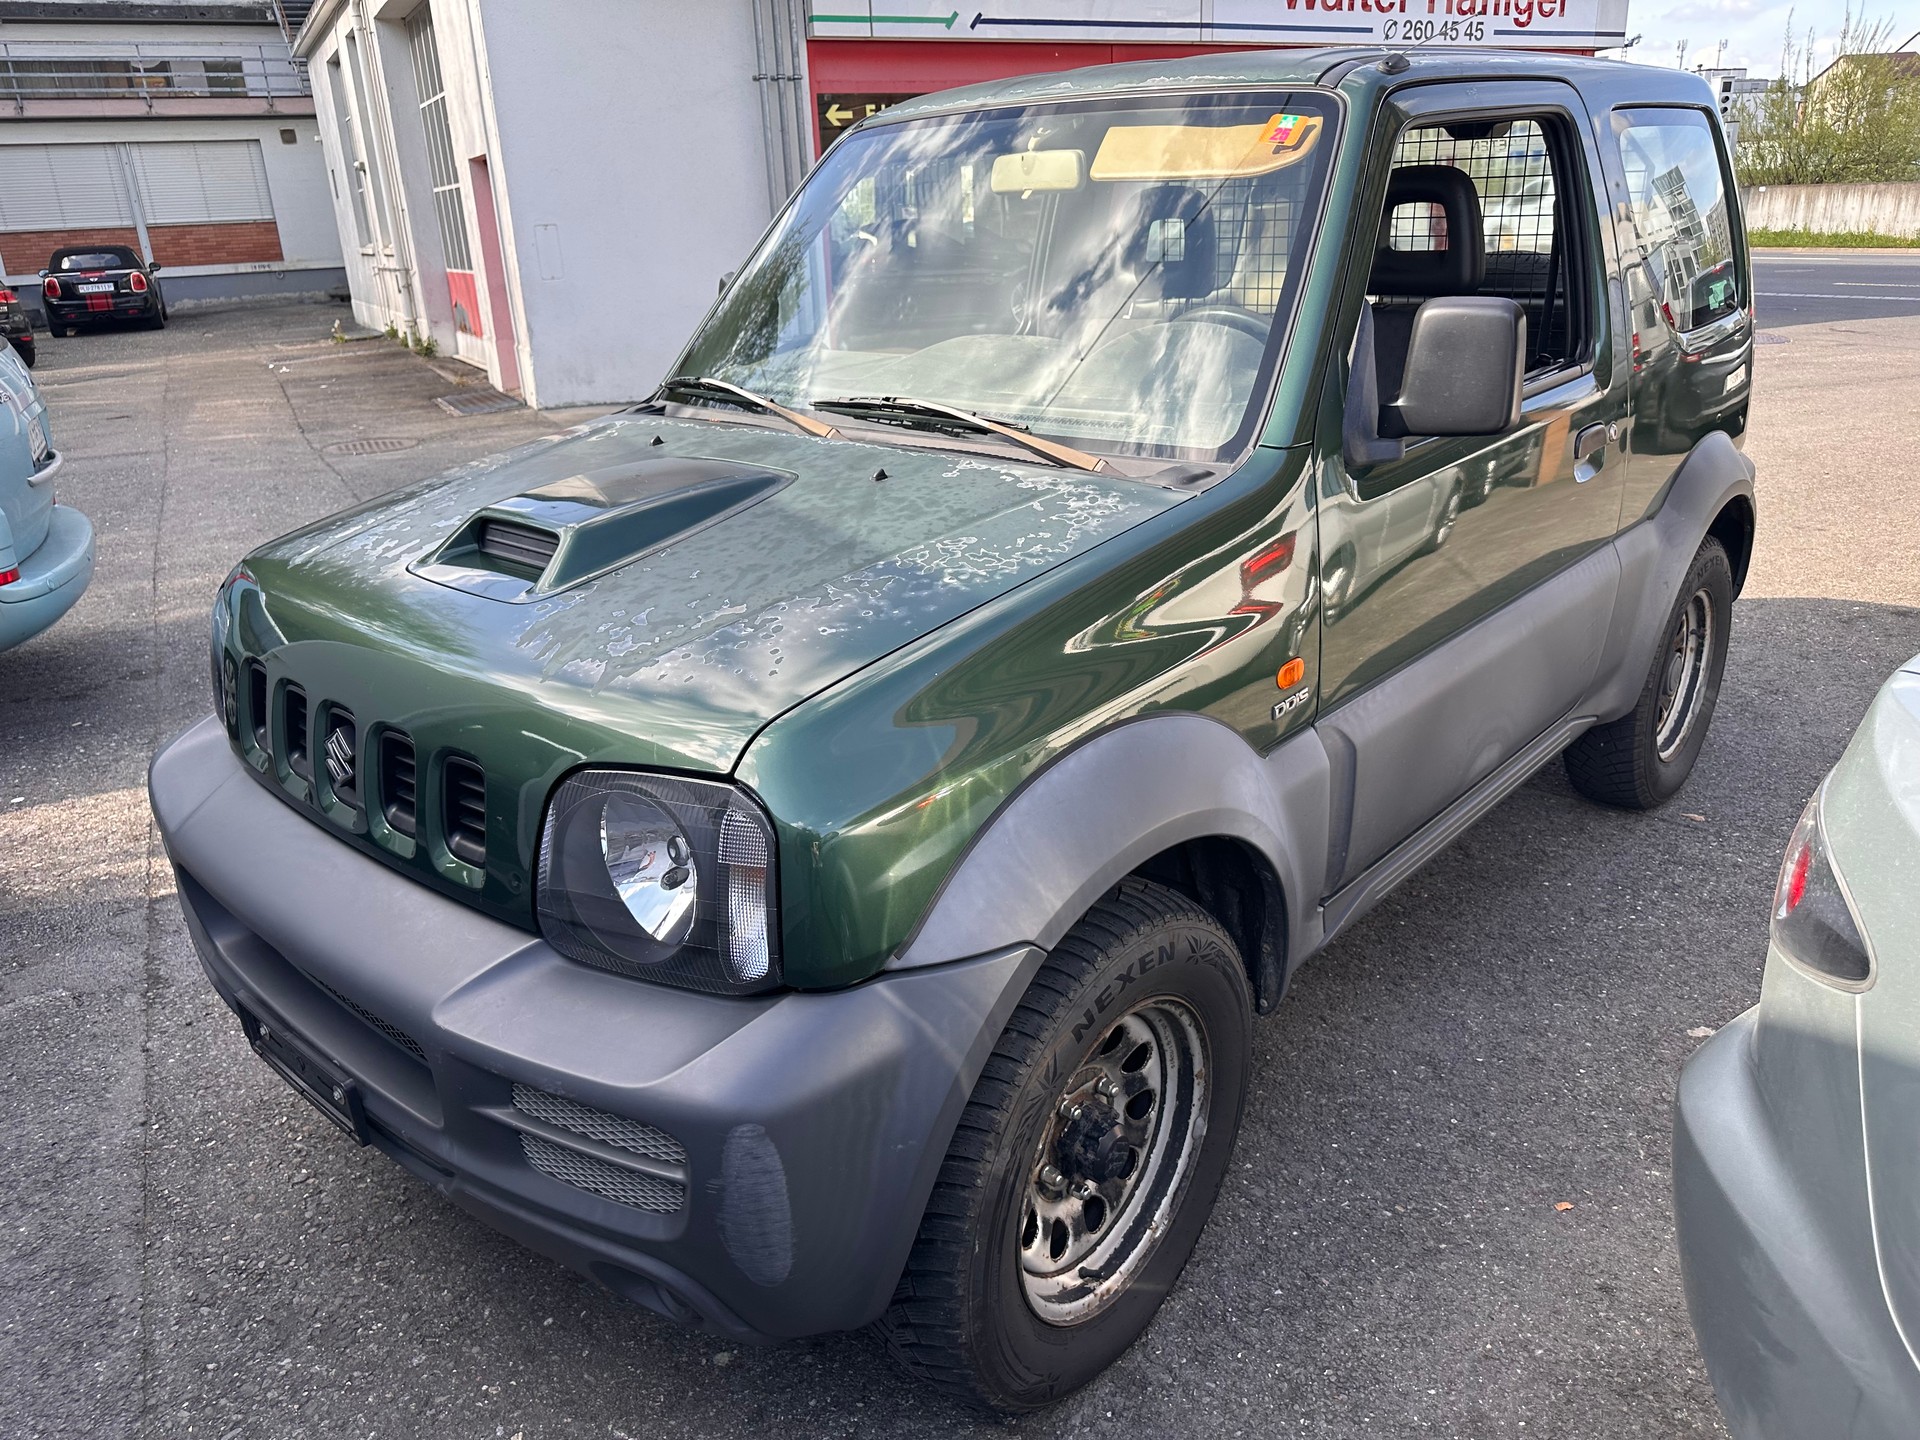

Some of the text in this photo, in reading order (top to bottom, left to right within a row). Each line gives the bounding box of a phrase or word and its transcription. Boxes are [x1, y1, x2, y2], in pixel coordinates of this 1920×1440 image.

[1402, 20, 1484, 41] 260 45 45
[1697, 555, 1725, 582] NEXEN
[1071, 941, 1176, 1045] NEXEN
